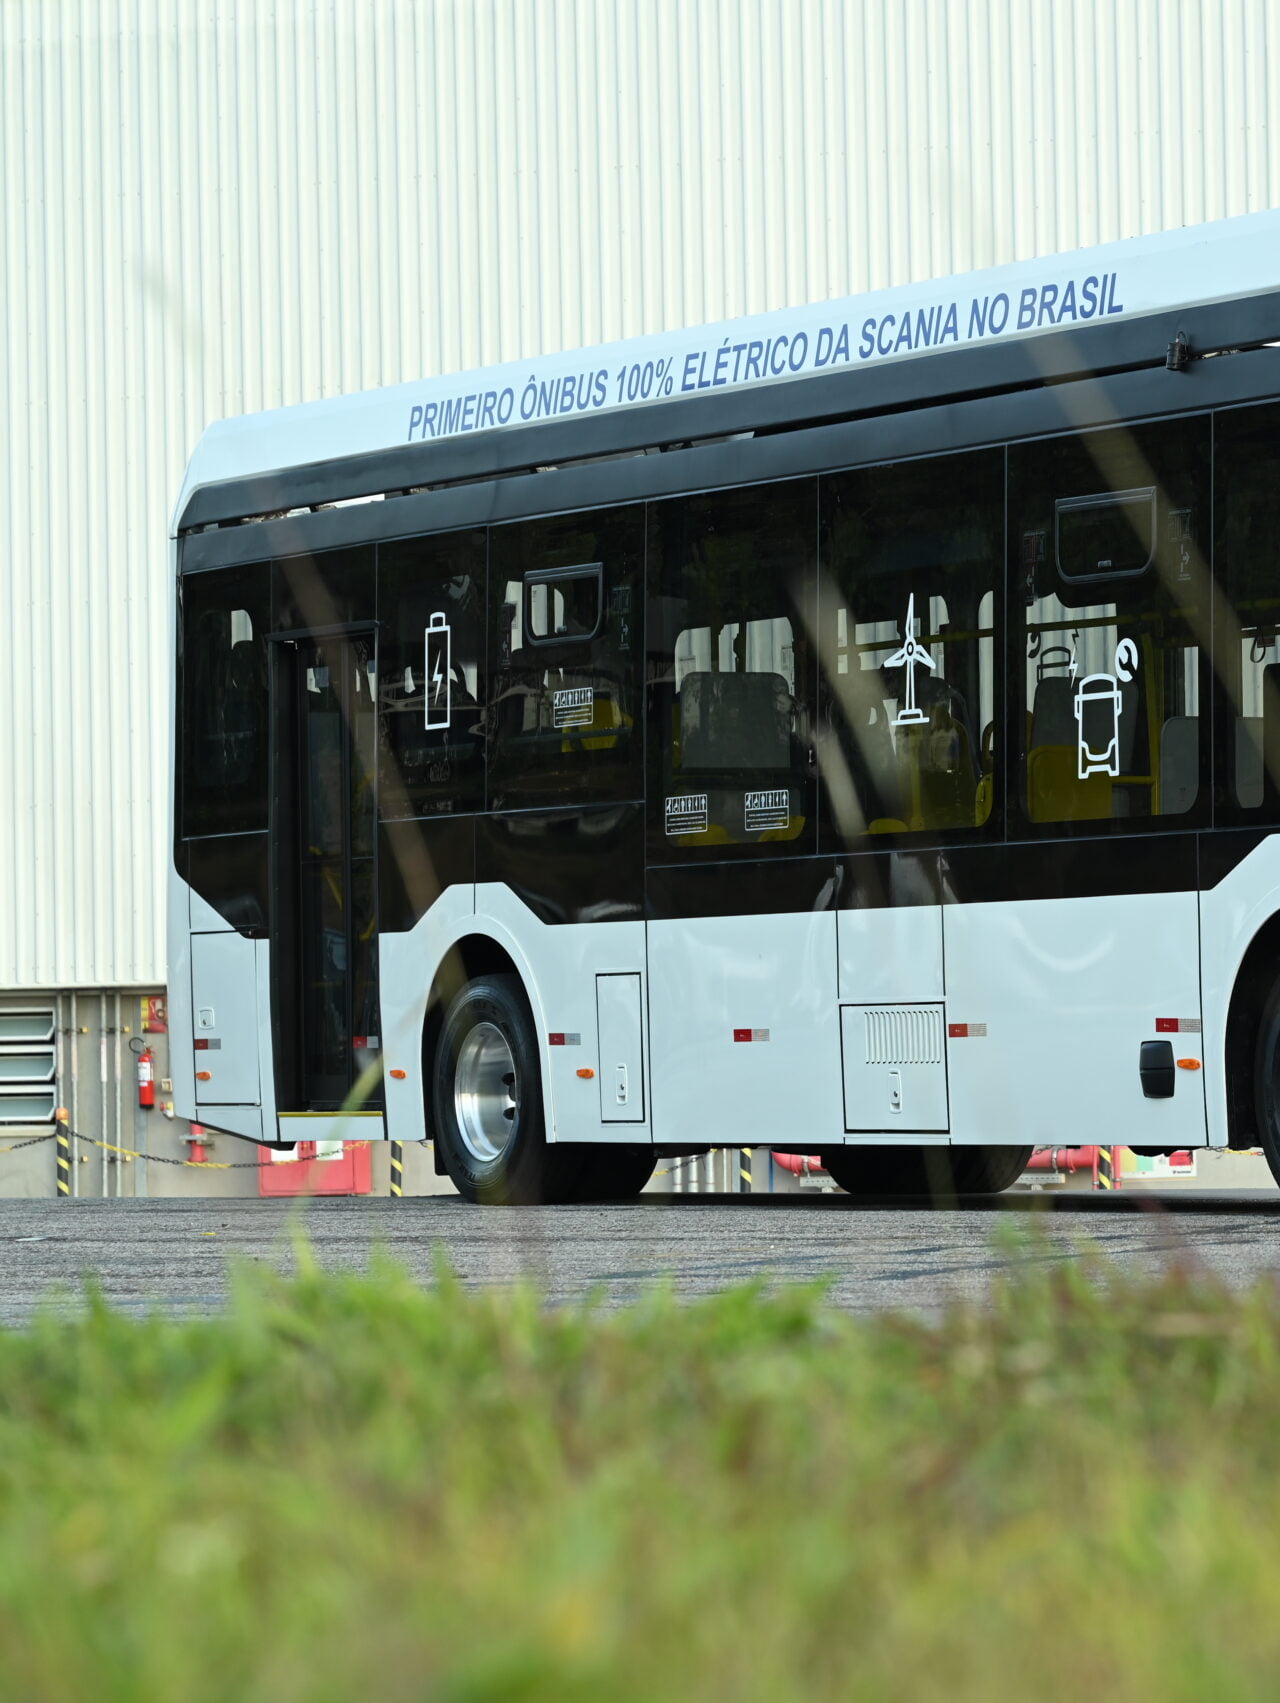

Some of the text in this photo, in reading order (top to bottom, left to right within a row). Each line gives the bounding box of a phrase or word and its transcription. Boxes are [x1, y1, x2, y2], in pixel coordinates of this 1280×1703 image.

[408, 272, 1124, 441] PRIMEIRO ÔNIBUS 100% ELÉTRICO DA SCANIA NO BRASIL
